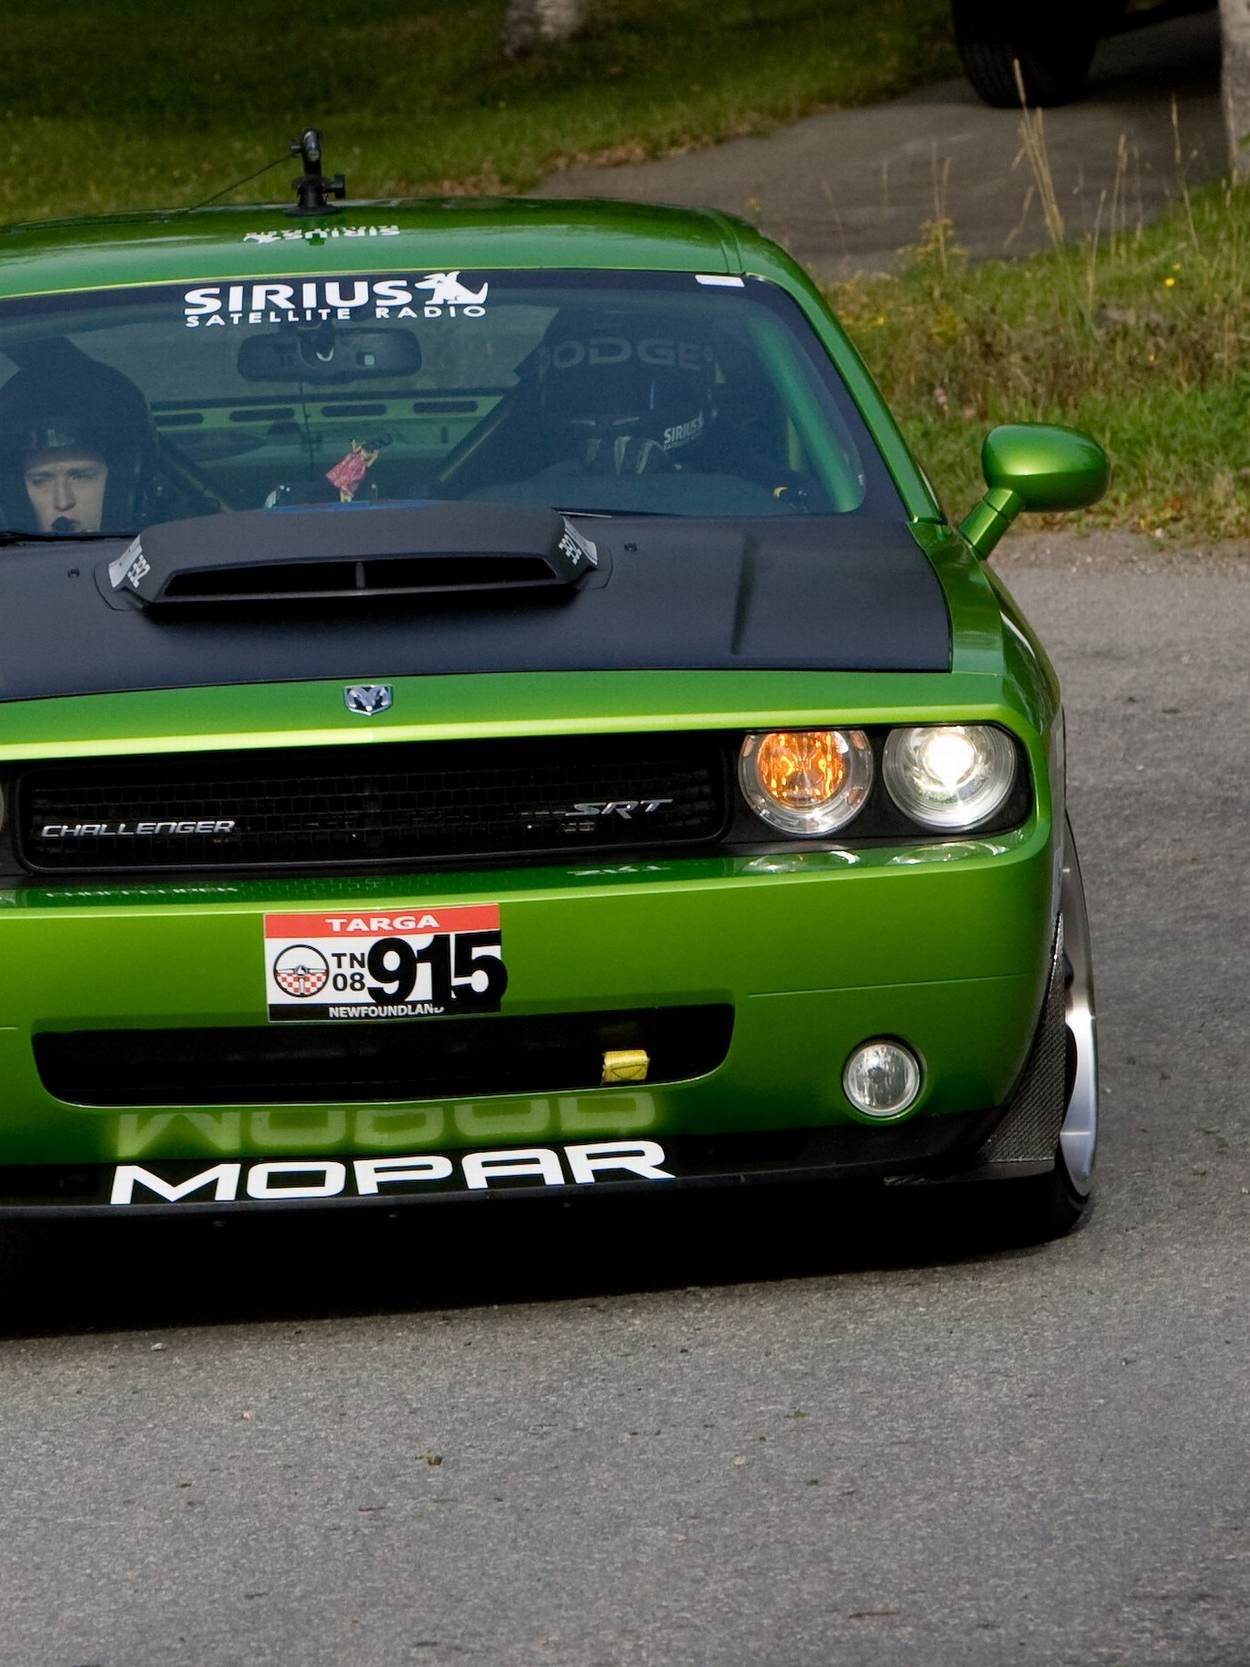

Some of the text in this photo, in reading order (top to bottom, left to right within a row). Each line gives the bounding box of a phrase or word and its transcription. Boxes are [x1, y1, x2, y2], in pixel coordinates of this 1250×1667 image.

[184, 279, 413, 316] SIRIUS
[186, 305, 487, 328] SATELLITE RADIO
[544, 337, 701, 371] ODGE
[564, 798, 674, 820] SRT
[40, 820, 237, 838] CHALLENGER
[325, 914, 440, 933] TARGA
[331, 952, 366, 970] TN
[366, 929, 509, 1006] 915
[332, 972, 366, 992] 08
[110, 1140, 677, 1206] MOPAR
